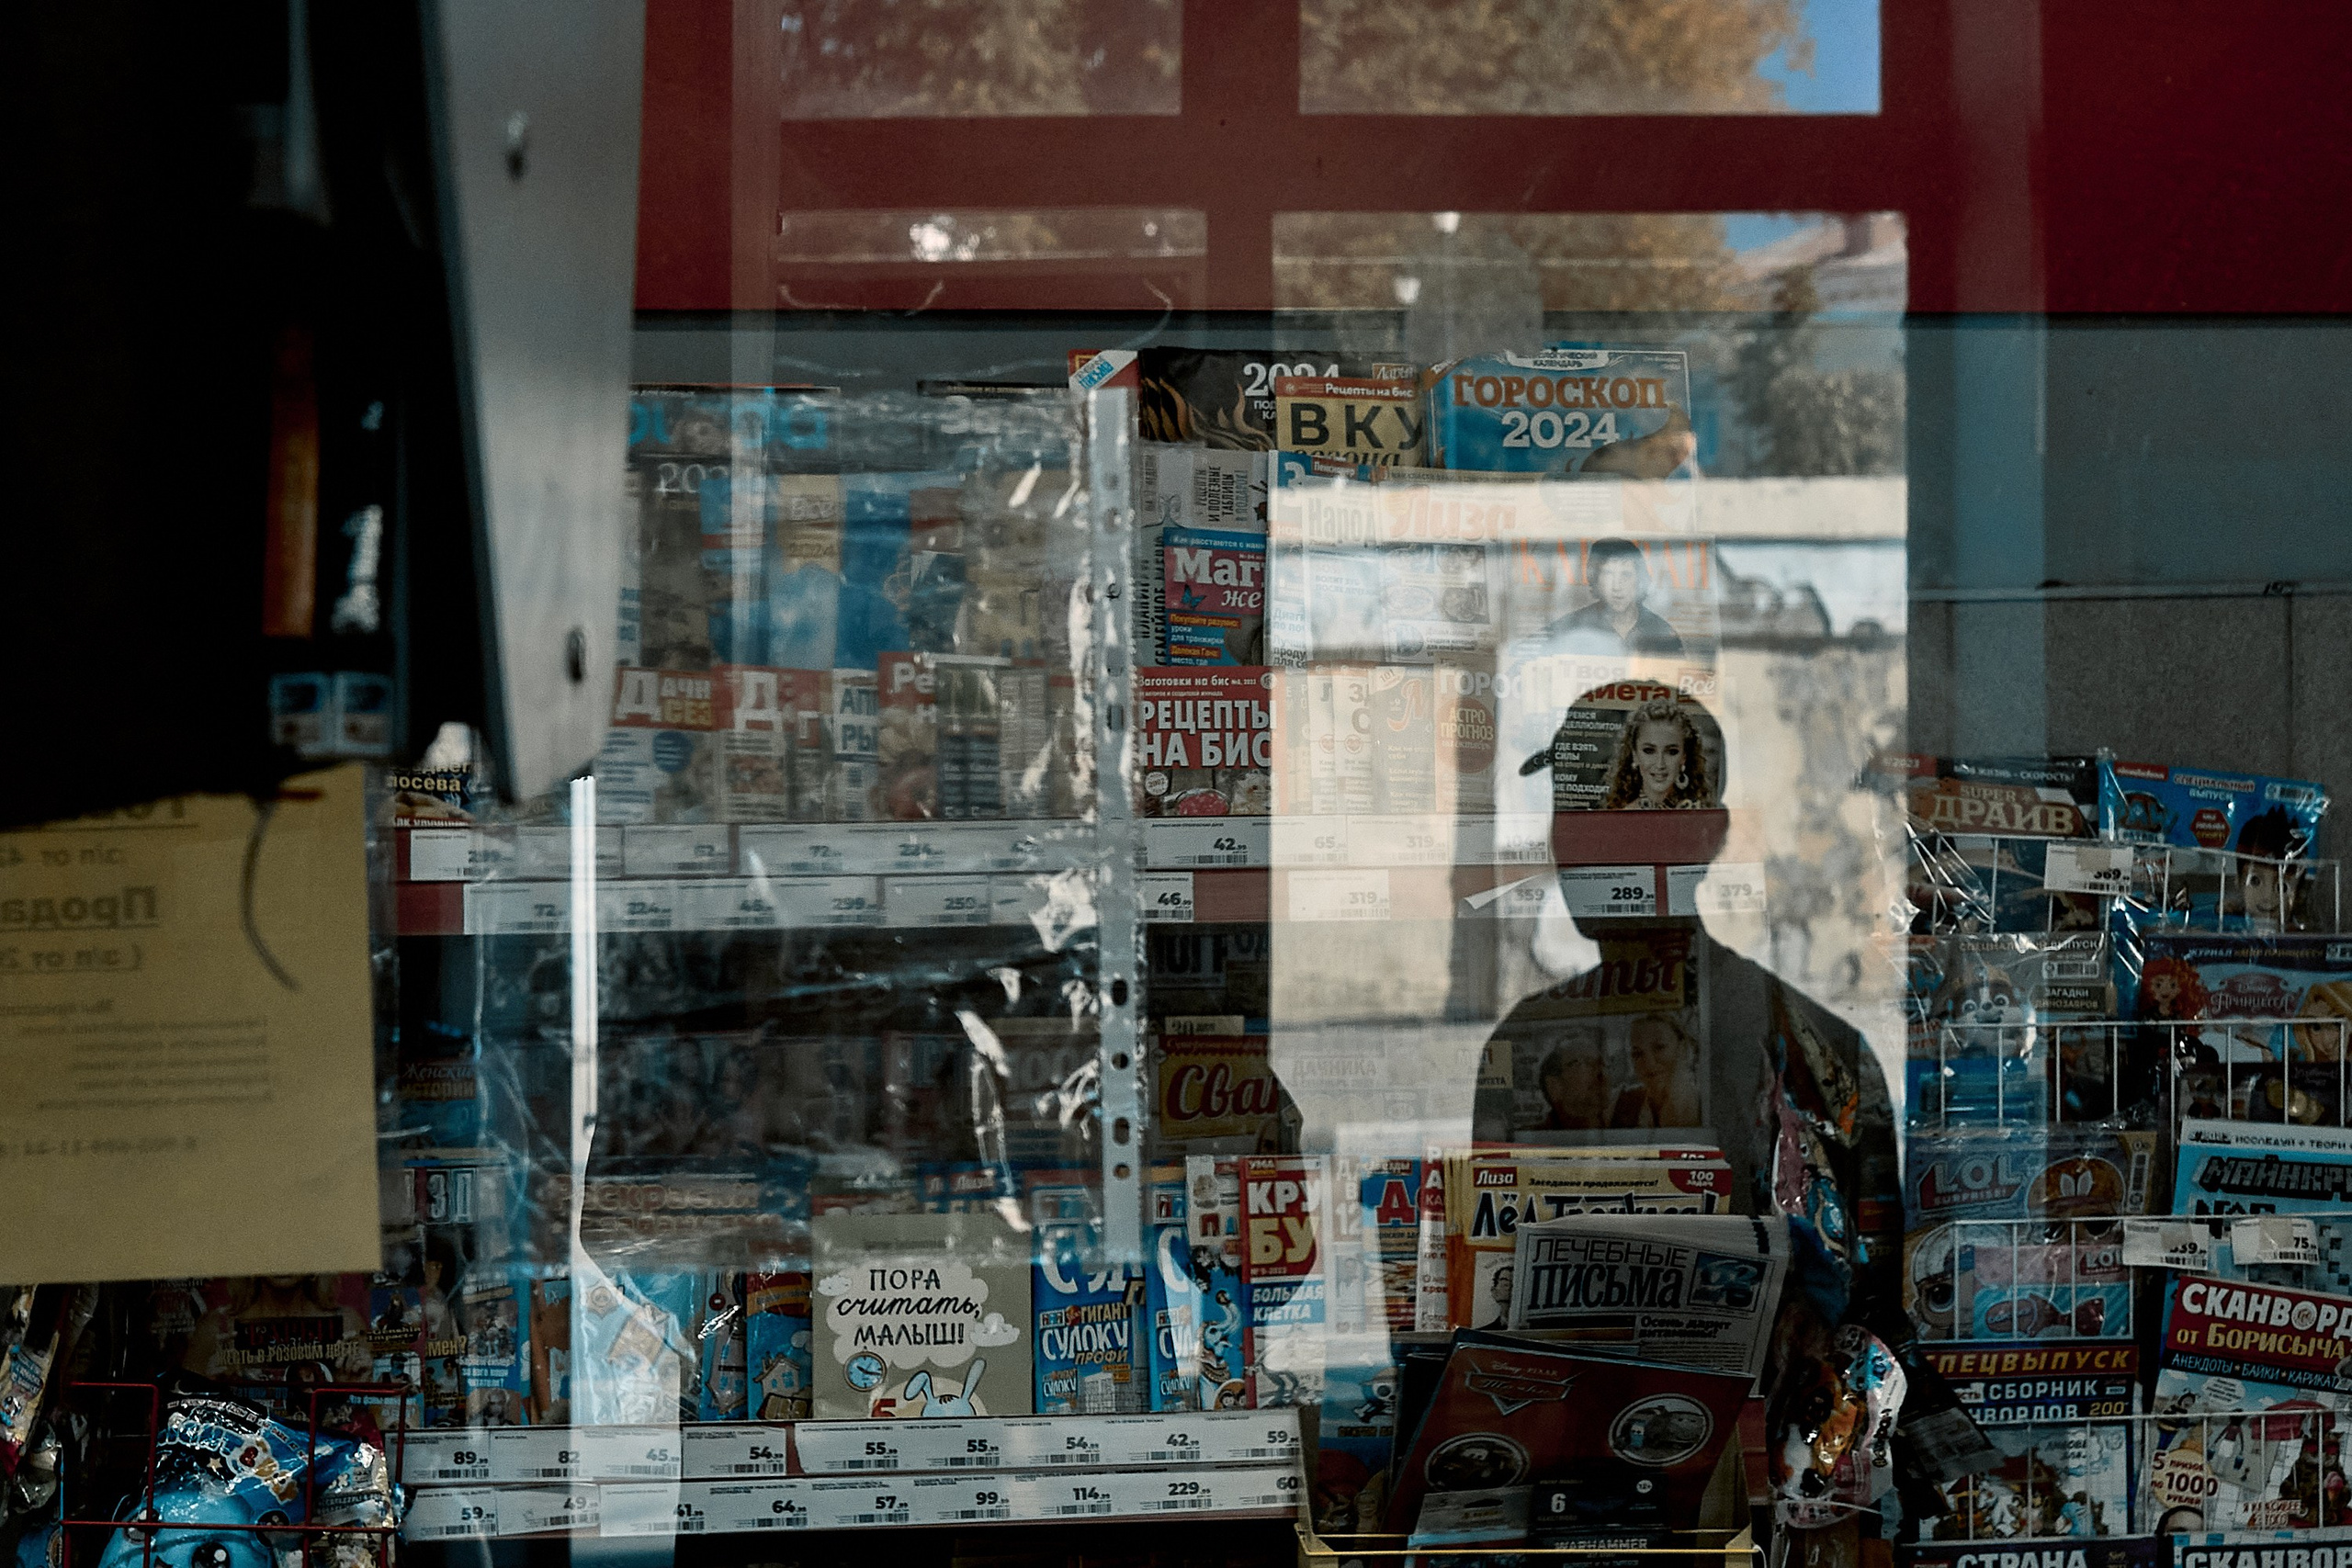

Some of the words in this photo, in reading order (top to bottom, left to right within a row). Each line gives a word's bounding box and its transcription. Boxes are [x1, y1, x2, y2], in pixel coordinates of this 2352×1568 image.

[1326, 383, 1375, 396] Рецепты
[1377, 387, 1391, 397] на
[1392, 386, 1413, 398] бис
[1452, 375, 1668, 410] ГОРОСКОП
[1500, 410, 1621, 449] 2024
[1191, 537, 1238, 548] расстаются
[1220, 589, 1261, 608] же
[1170, 634, 1185, 642] для
[1558, 660, 1625, 681] Твоя
[1195, 678, 1208, 686] на
[1211, 675, 1229, 687] бис
[1140, 699, 1277, 735] РЕЦЕПТЫ
[1449, 707, 1487, 723] АСТРО
[1441, 723, 1494, 741] ПРОГНОЗ
[1140, 731, 1190, 768] НА
[1201, 731, 1275, 769] БИС
[1960, 784, 2017, 802] SUPER
[2188, 787, 2233, 802] ВЫПУСК
[1476, 1169, 1514, 1186] Лиза
[1689, 1170, 1715, 1181] 100
[2199, 1154, 2352, 1200] МАЙНКР
[1376, 1179, 1422, 1226] Д
[1532, 1238, 1690, 1269] ЛЕЧЕБНЫЕ
[869, 1269, 941, 1292] ПОРА
[1252, 1285, 1325, 1304] БОЛЬШАЯ
[837, 1296, 981, 1319] считать,
[1081, 1303, 1132, 1324] ГИГАНТ
[1252, 1303, 1312, 1323] КЛЕТКА
[1641, 1315, 1685, 1329] Осень
[1686, 1319, 1733, 1331] дарит
[854, 1323, 965, 1346] МАЛЫШ!
[2176, 1328, 2200, 1346] от
[1075, 1348, 1129, 1366] ПРОФИ
[1926, 1348, 2132, 1375] ПЕЦВЫПУСК
[2170, 1352, 2234, 1375] АНЕКДОТЫ
[2241, 1363, 2280, 1381] БАЙКИ
[1527, 1366, 1558, 1377] PIXAR
[1987, 1380, 2099, 1401] СБОРНИК
[2153, 1451, 2168, 1471] 5
[2165, 1472, 2219, 1497] 1000
[1550, 1492, 1567, 1514] 6
